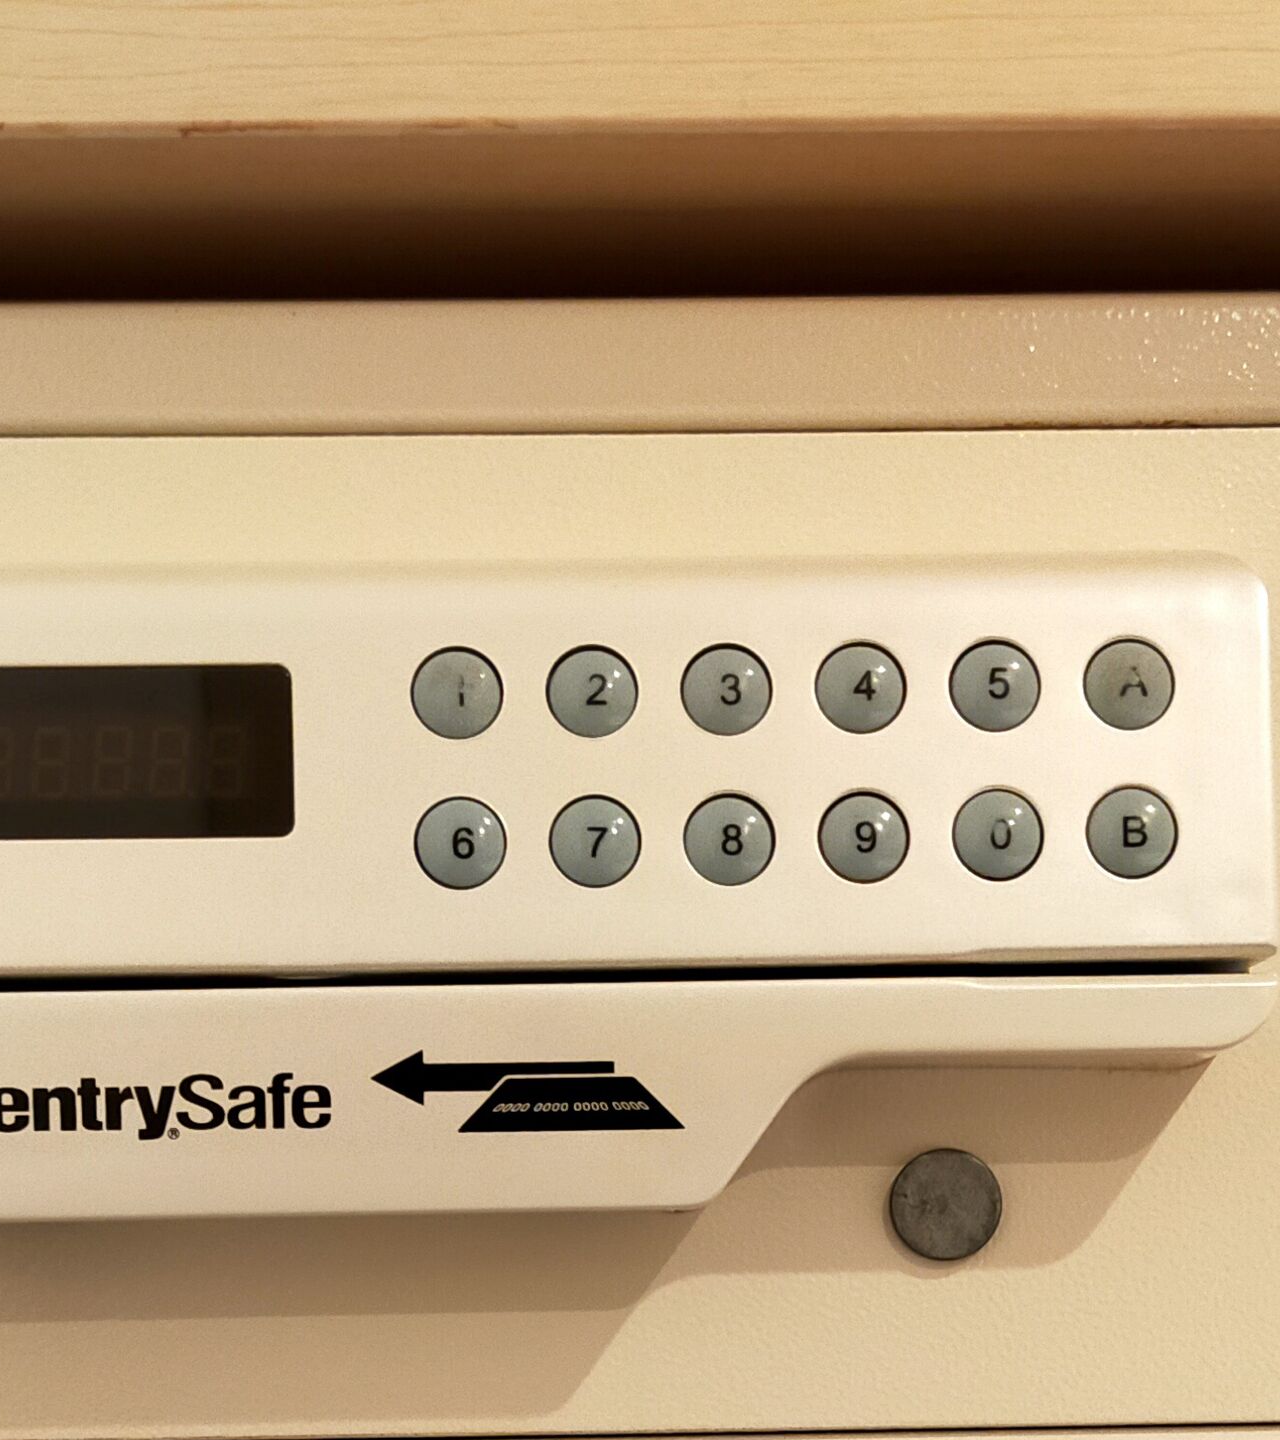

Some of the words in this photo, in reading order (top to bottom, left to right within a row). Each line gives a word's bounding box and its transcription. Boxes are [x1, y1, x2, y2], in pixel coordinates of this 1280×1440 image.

[584, 672, 611, 708] 2
[718, 672, 744, 708] 3
[851, 669, 878, 703] 4
[986, 666, 1012, 701] 5
[1119, 664, 1150, 698] A
[450, 824, 476, 862] 6
[584, 824, 609, 860] 7
[719, 822, 744, 858] 8
[853, 819, 878, 855] 9
[990, 816, 1014, 852] 0
[1121, 814, 1148, 848] B
